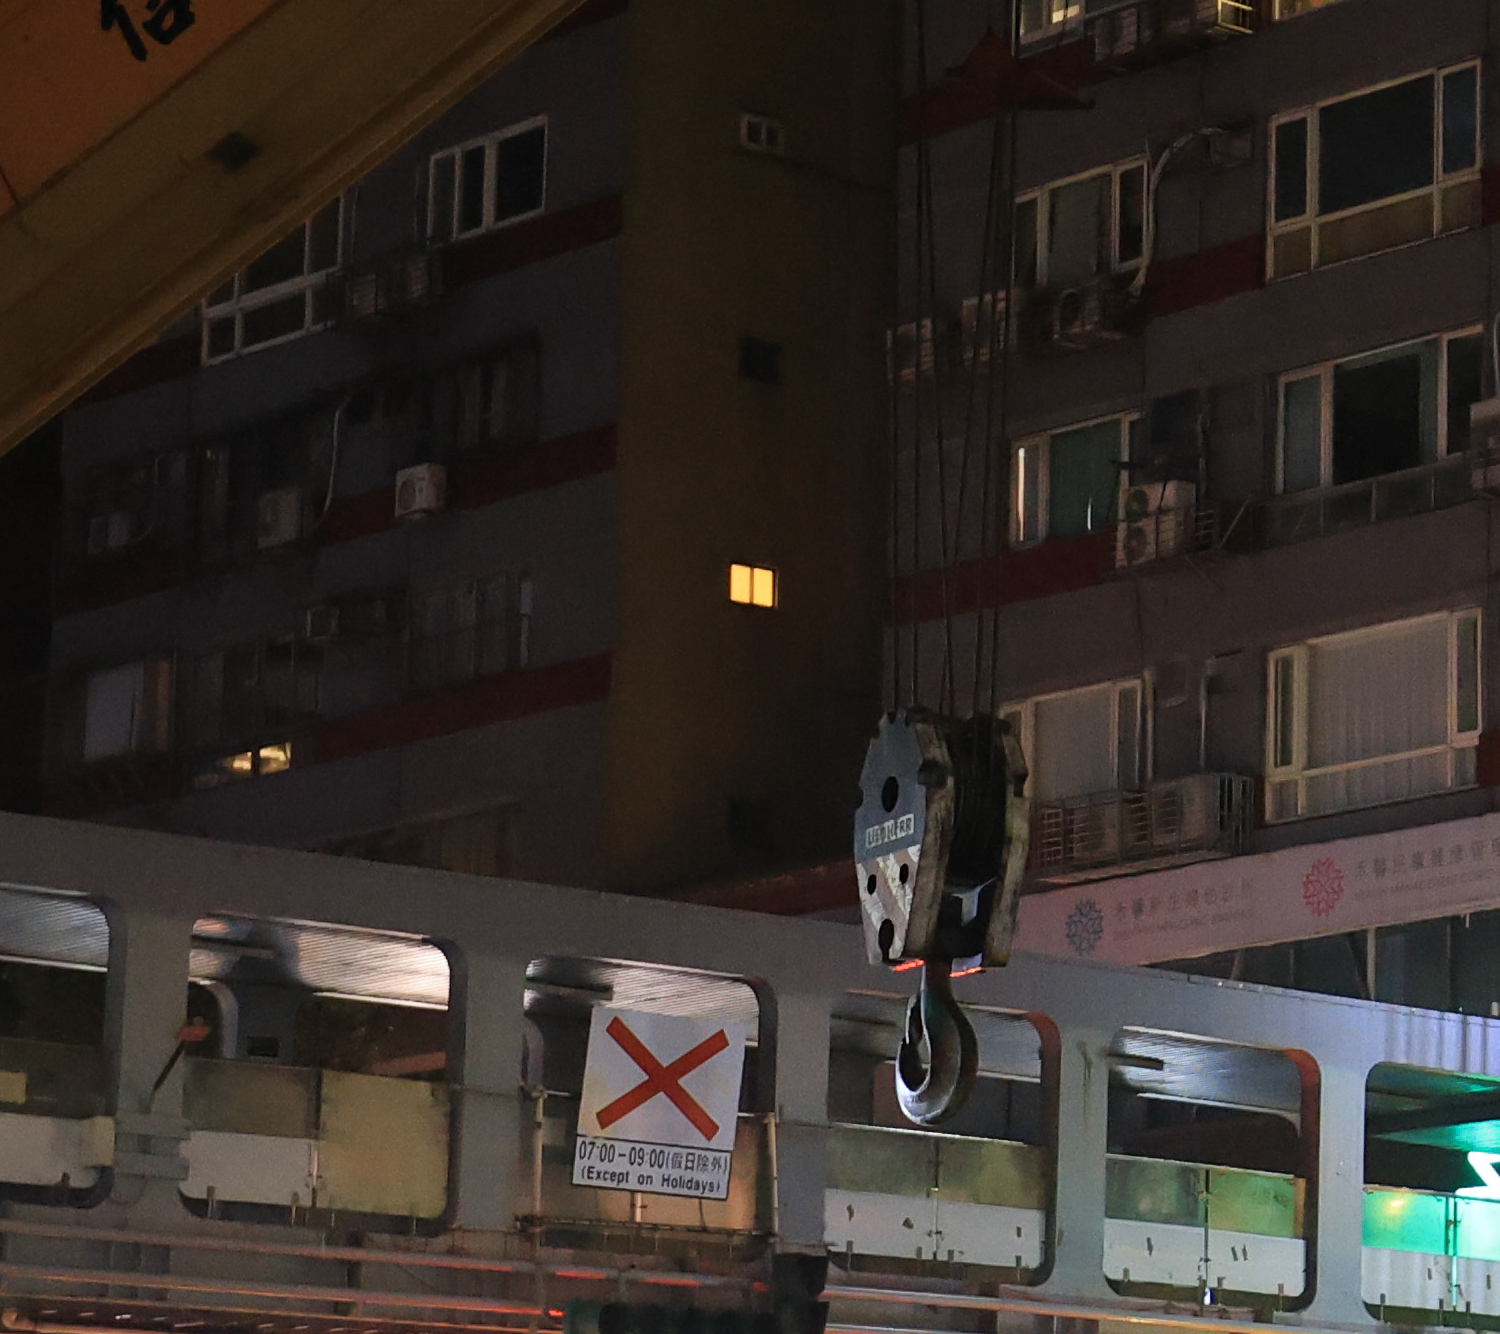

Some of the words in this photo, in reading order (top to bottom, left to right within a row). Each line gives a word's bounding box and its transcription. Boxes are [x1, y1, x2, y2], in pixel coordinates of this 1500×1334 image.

[581, 1166, 630, 1188] (Except
[637, 1173, 654, 1186] on
[661, 1174, 721, 1195] Holidays)
